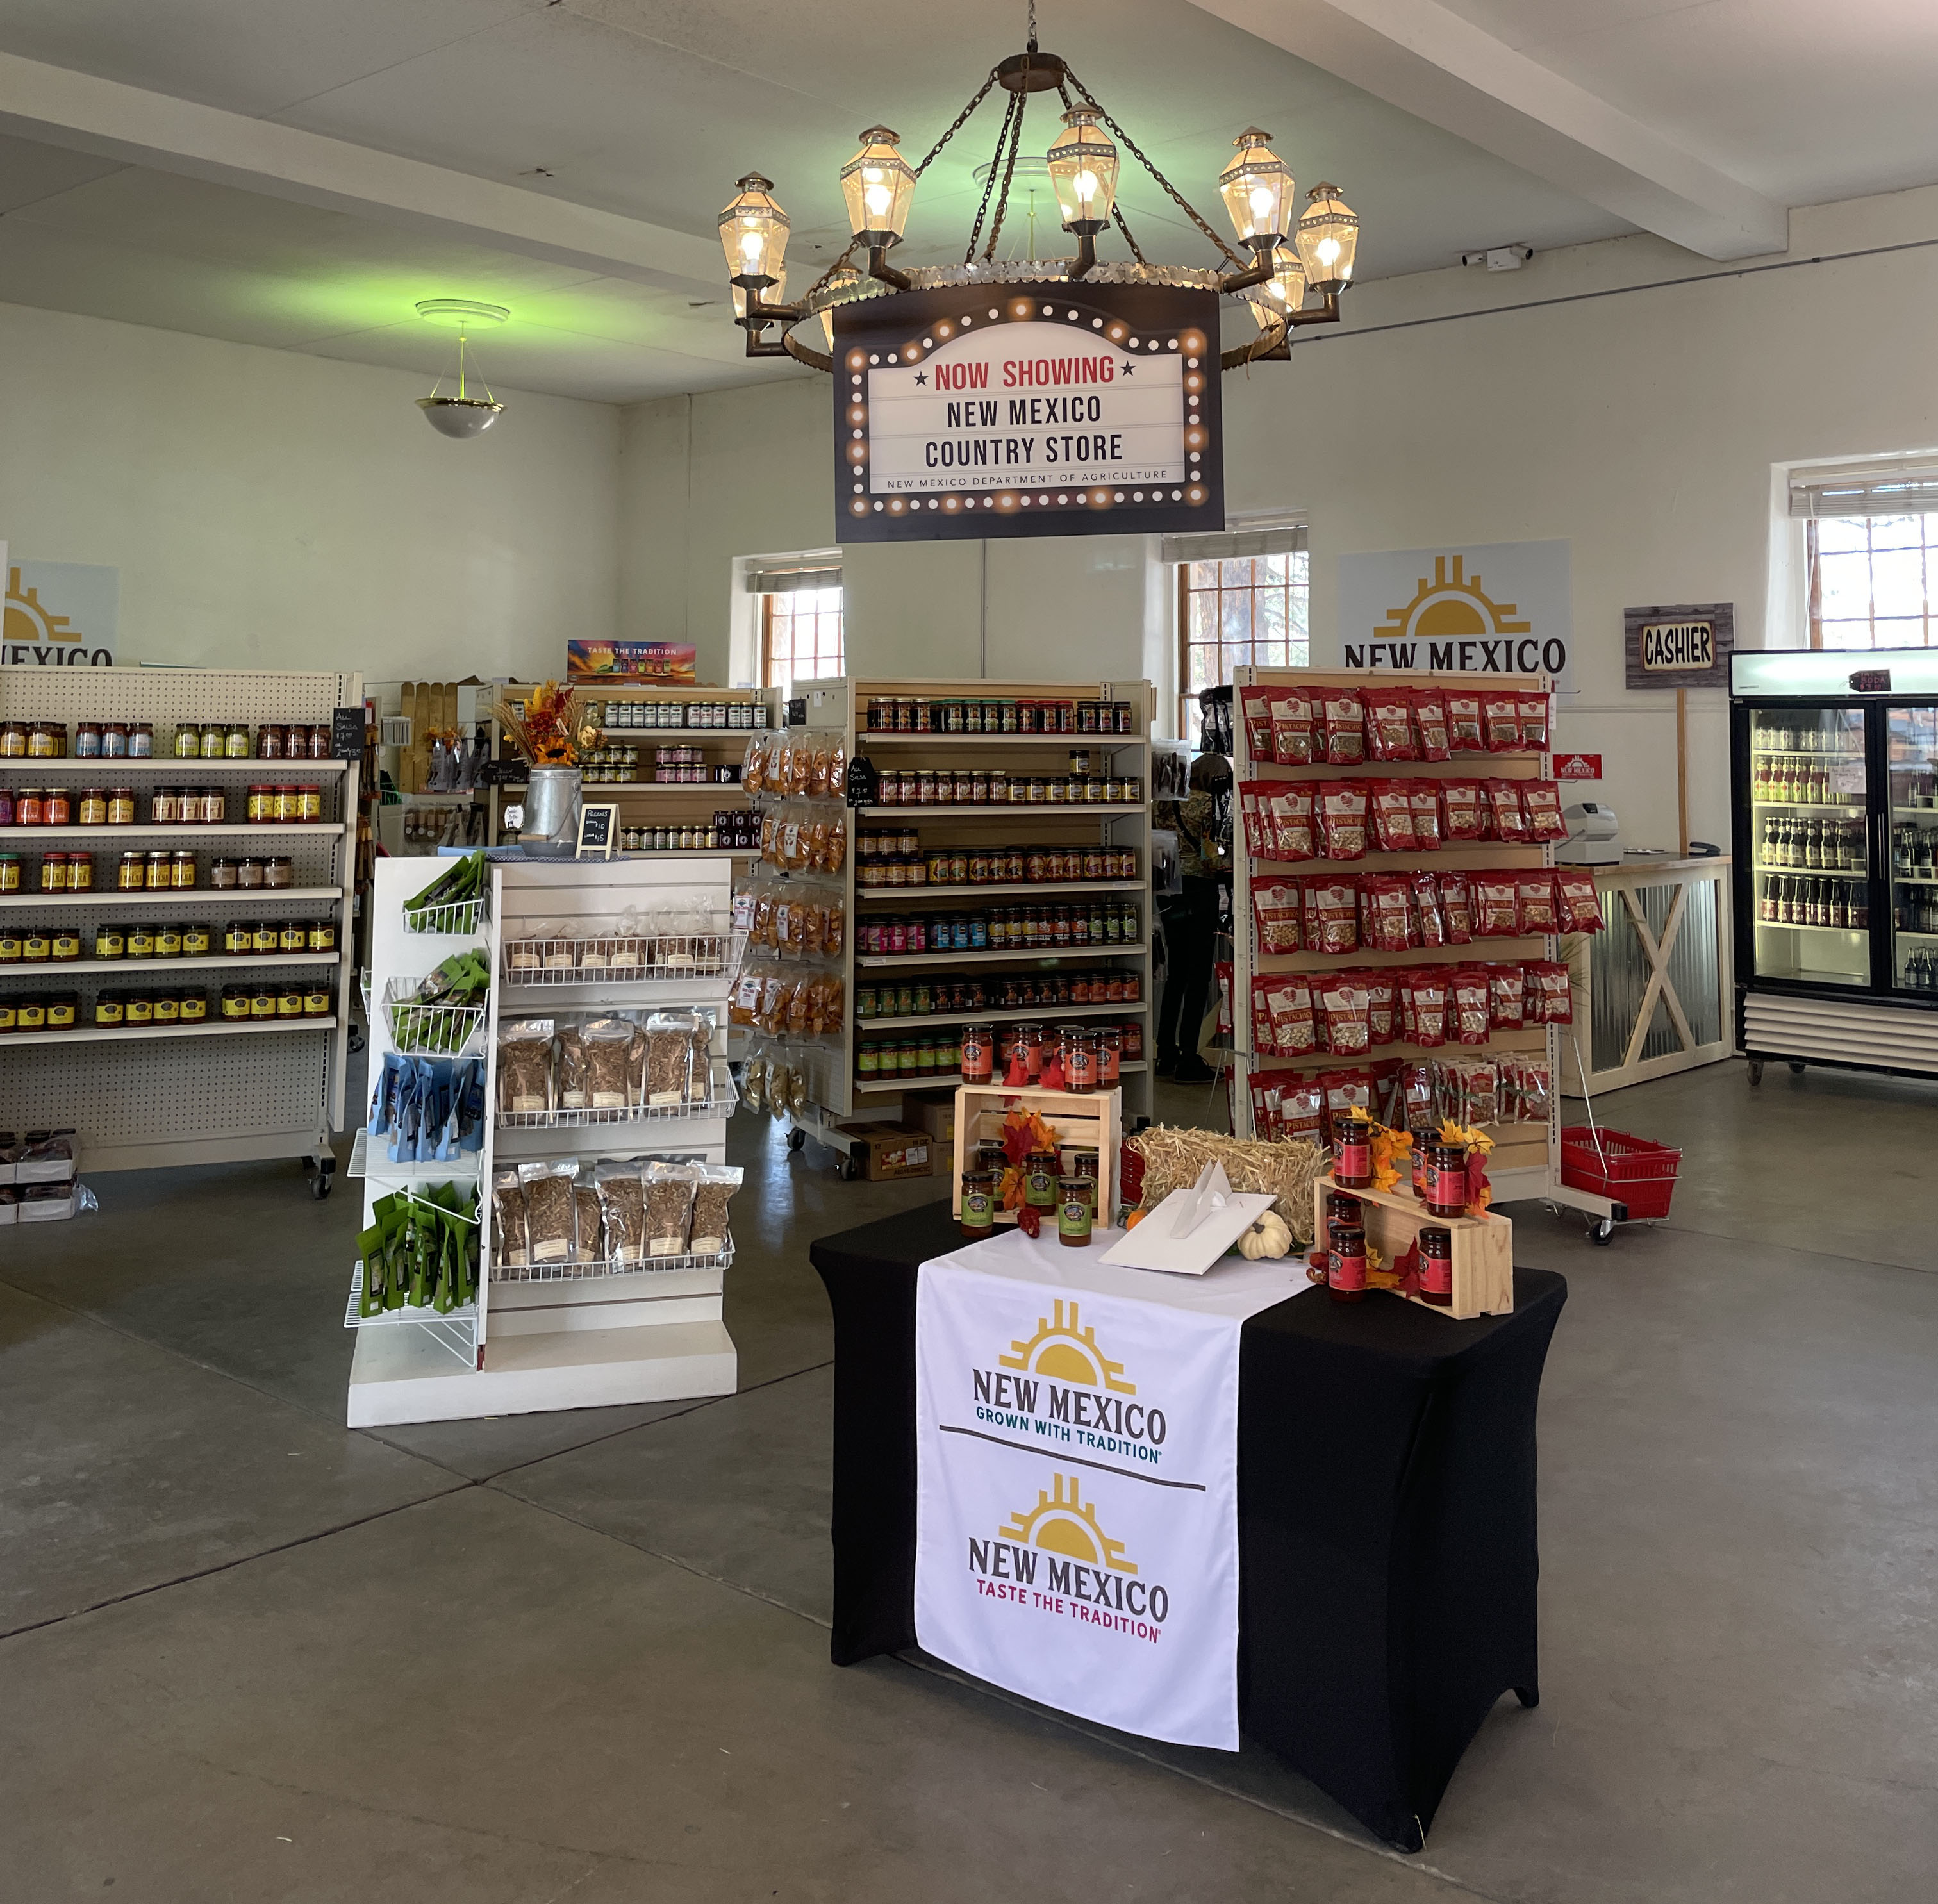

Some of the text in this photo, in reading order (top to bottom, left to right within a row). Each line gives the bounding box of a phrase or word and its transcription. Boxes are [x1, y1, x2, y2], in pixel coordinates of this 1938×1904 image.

[935, 356, 1114, 390] NOW SHOWING
[947, 395, 1100, 427] NEW MEXICO
[925, 433, 1122, 467] COUNTRY STORE
[888, 470, 1168, 488] NEW MEXICO DEPARTMENT OF AGRICULTURE
[2, 645, 112, 666] EXICO
[1344, 638, 1566, 674] NEW MEXICO
[1645, 625, 1711, 665] CASHIER
[173, 873, 192, 882] SASA
[973, 1369, 1166, 1445] NEW MEXICO
[977, 1405, 1029, 1432] GROWN
[1034, 1418, 1071, 1443] WITH
[968, 1537, 1168, 1624] NEW MEXICO
[977, 1578, 1027, 1605] TASTE
[1033, 1592, 1064, 1614] THE
